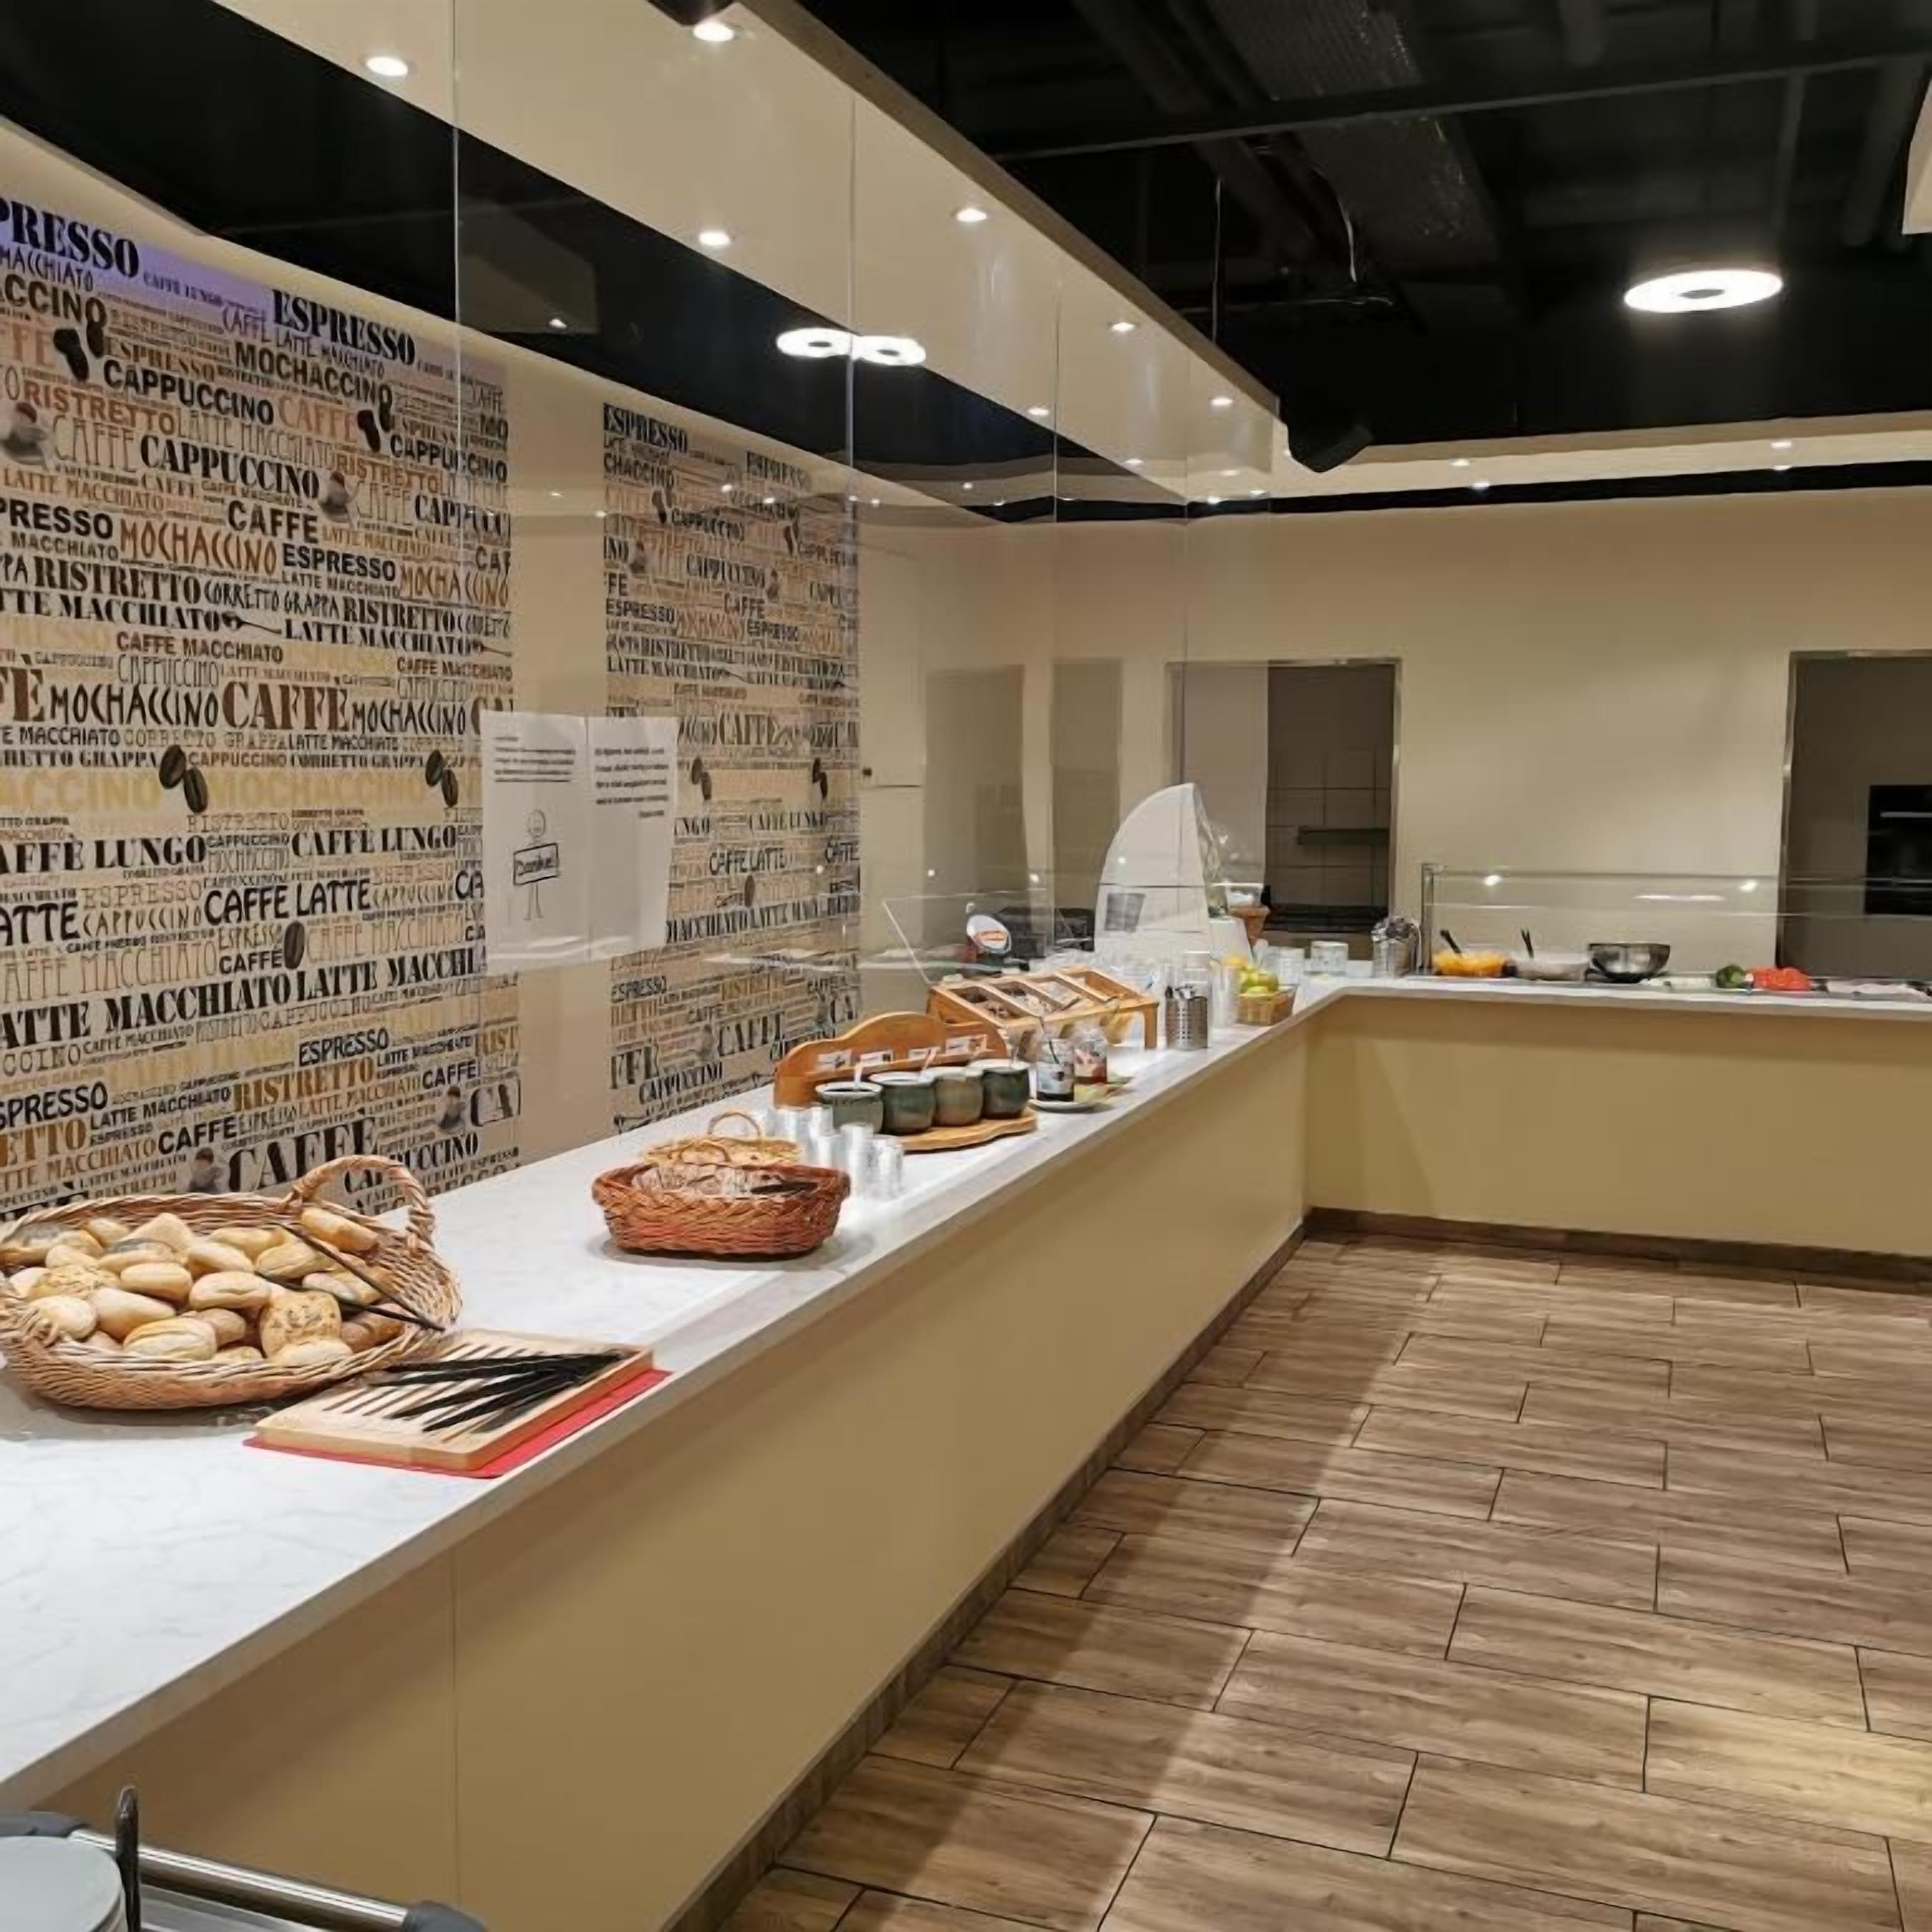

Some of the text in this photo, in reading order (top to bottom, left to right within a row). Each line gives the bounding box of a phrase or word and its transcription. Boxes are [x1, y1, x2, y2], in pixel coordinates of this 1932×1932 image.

[0, 274, 108, 327] CCINO
[272, 289, 415, 365] ESPRESSO
[103, 359, 274, 425] CAPPUCCINO
[235, 340, 392, 408] MOCHACCINO
[24, 379, 176, 436] RISTRETTO
[4, 467, 62, 494] LATTE
[140, 434, 319, 499] CAPPUCCINO
[11, 530, 119, 562] MACCHIATO
[228, 499, 319, 544] CAFFE
[119, 518, 277, 577] MOCHACCINO
[282, 542, 396, 582] ESPRESSO
[0, 553, 28, 584] PA
[34, 555, 201, 605] RISTRETTO
[203, 578, 280, 613] CORRETTO
[284, 588, 340, 616] GRAPPA
[341, 594, 455, 633] RISTRETTO
[281, 570, 321, 590] LATTE
[59, 592, 220, 631] MACCHIATO
[284, 618, 354, 645] LATTE
[359, 630, 472, 657] MACCHIATO
[183, 636, 284, 664] MACCHIATO
[50, 683, 219, 728] MOCHACCINO
[352, 698, 466, 735] MOCHACCINO
[19, 726, 121, 747] MACCHIATO
[289, 734, 328, 750] LATTE
[94, 835, 207, 869] LUNGO
[381, 824, 457, 852] LUNGO
[81, 880, 202, 909] ESPRESSO
[204, 884, 289, 926] CAFFE
[296, 877, 372, 918] LATTE
[83, 904, 202, 938] CAPPUCCINO
[80, 940, 218, 994] MACCHIATO
[104, 972, 292, 1033] MACCHIATO
[296, 959, 378, 1002] LATTE
[299, 1027, 389, 1067] ESPRESSO
[233, 1055, 375, 1112] RISTRETTO
[422, 1059, 477, 1091] CAFFE
[91, 1106, 137, 1131] LATTE
[143, 1085, 231, 1119] MACCHIATO
[47, 1137, 157, 1180] MACCHIATO
[158, 1116, 237, 1155] CAFFE
